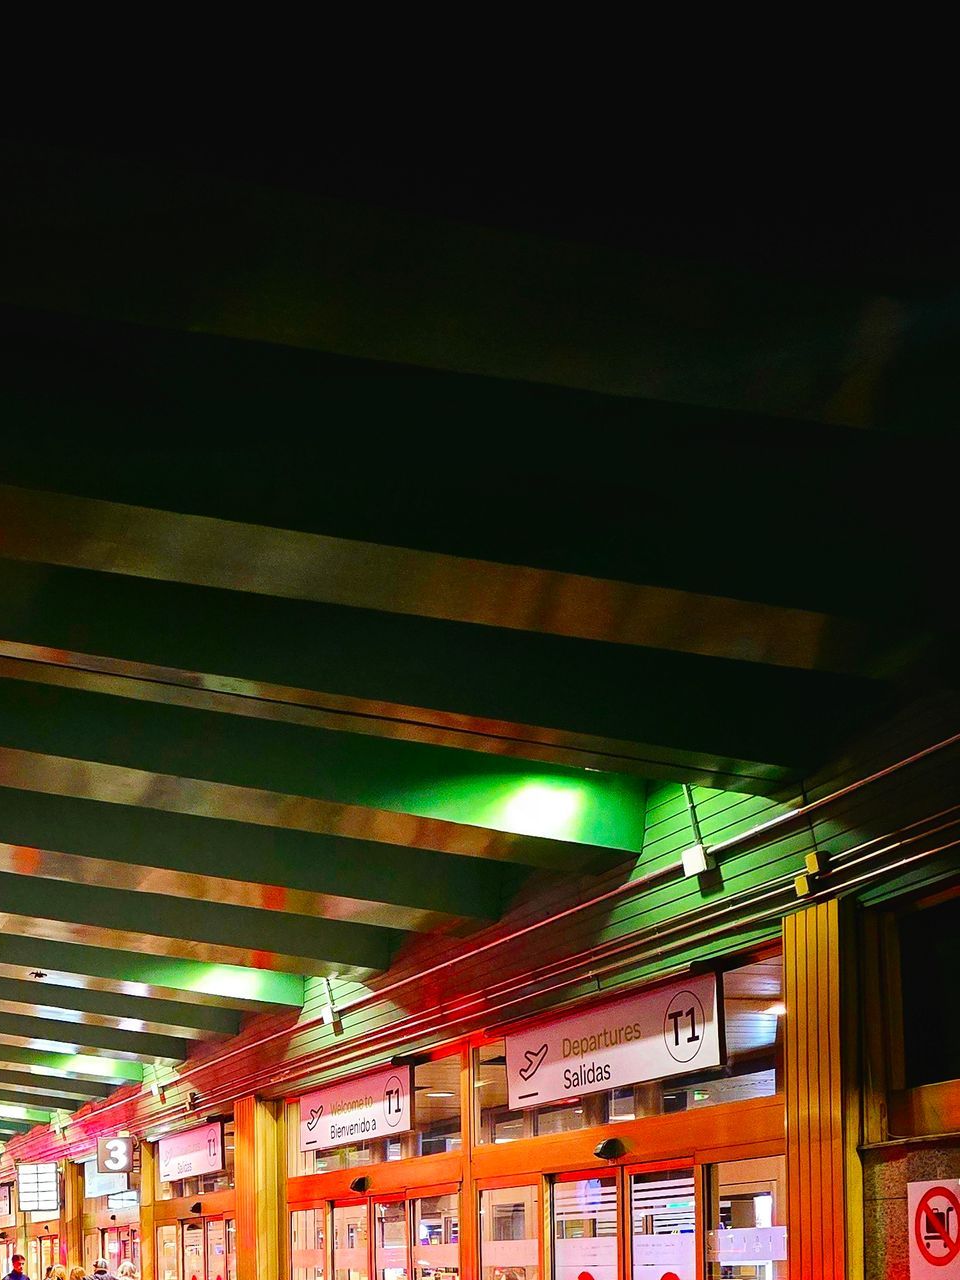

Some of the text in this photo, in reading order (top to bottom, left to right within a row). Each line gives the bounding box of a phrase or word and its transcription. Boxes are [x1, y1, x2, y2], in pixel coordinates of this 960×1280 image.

[562, 1021, 641, 1059] Departures
[667, 1006, 701, 1047] T1
[563, 1061, 611, 1090] Salidas
[385, 1087, 402, 1115] T1
[330, 1116, 377, 1140] Bienvenido a
[104, 1139, 128, 1171] 3
